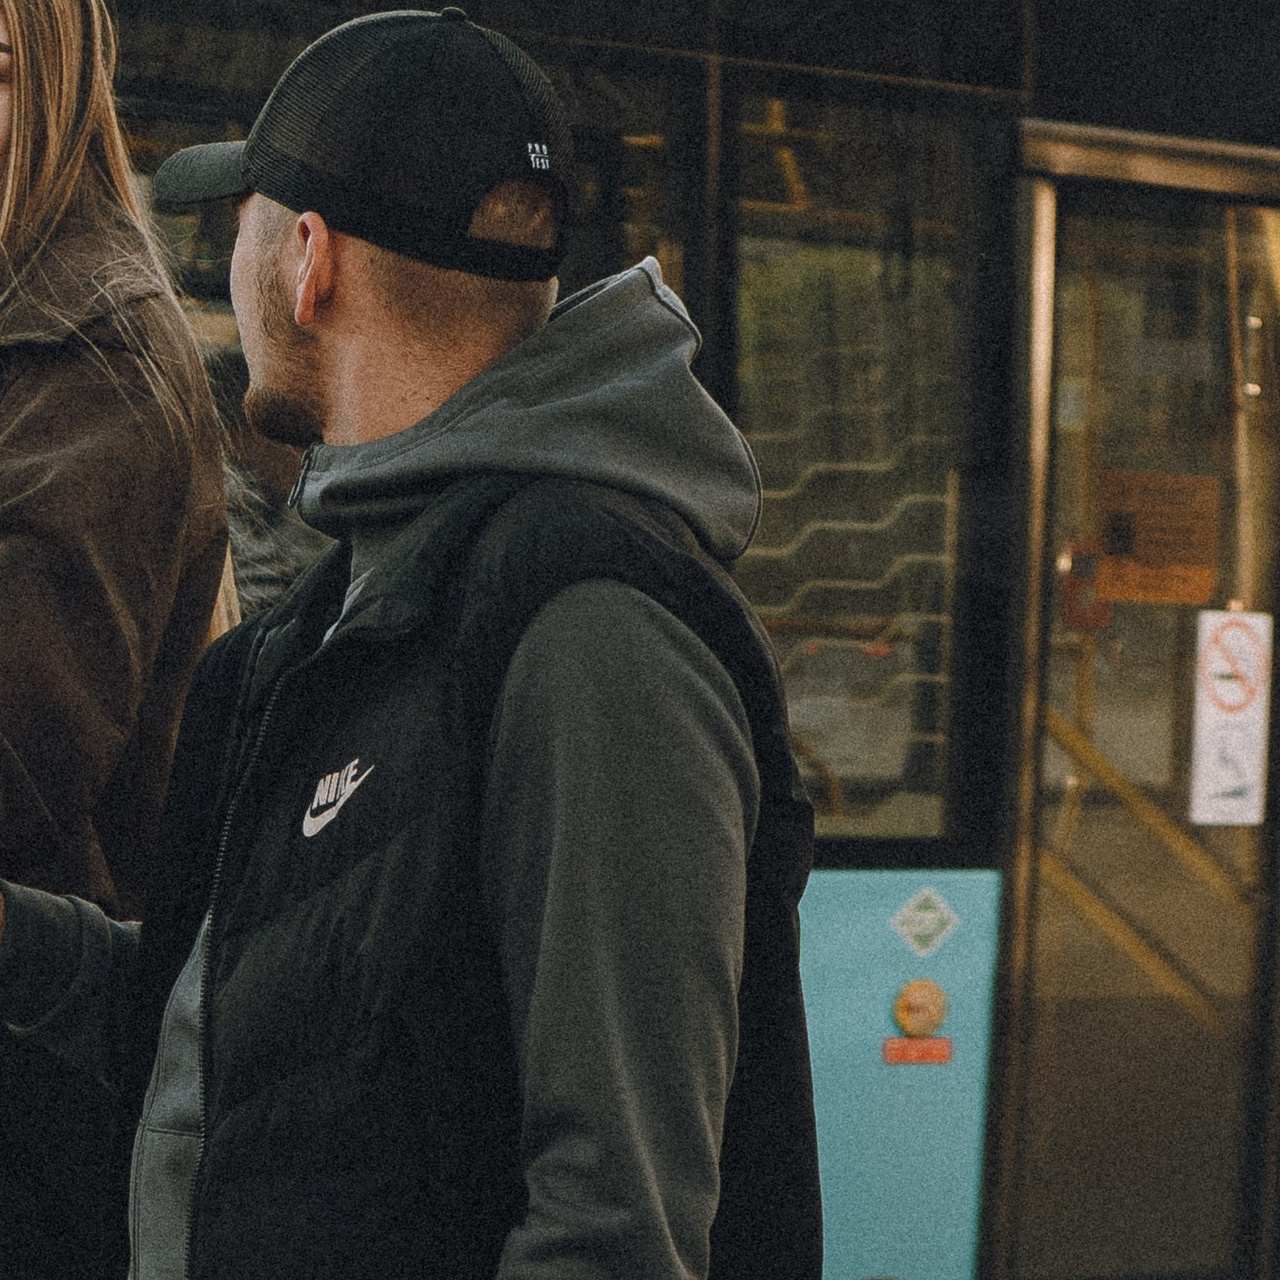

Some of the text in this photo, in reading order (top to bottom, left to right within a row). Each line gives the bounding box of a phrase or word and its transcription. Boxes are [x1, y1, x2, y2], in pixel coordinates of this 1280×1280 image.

[527, 143, 548, 155] PRO
[529, 154, 550, 170] TEST
[311, 757, 360, 810] NIKE
